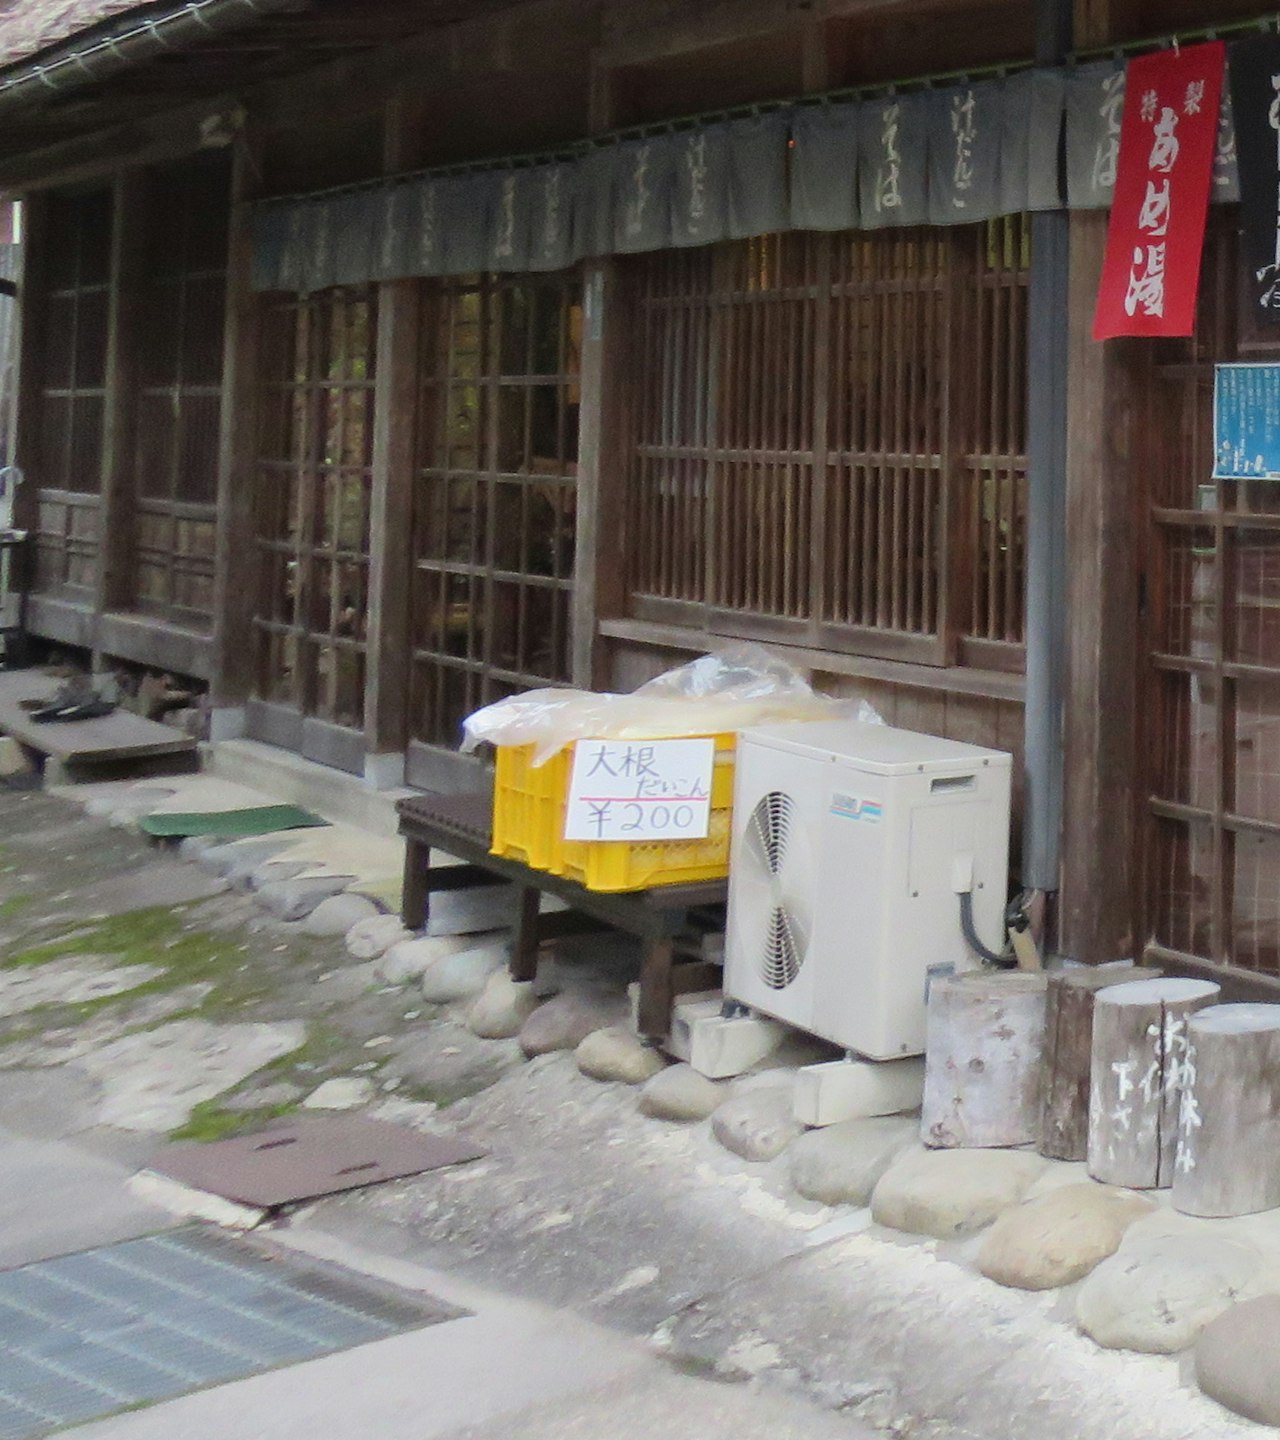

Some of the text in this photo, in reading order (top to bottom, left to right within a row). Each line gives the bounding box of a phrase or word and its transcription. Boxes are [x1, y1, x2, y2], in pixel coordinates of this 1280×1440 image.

[1125, 107, 1179, 318] あめ湯
[586, 745, 659, 777] 大根
[636, 775, 709, 799] だいこん
